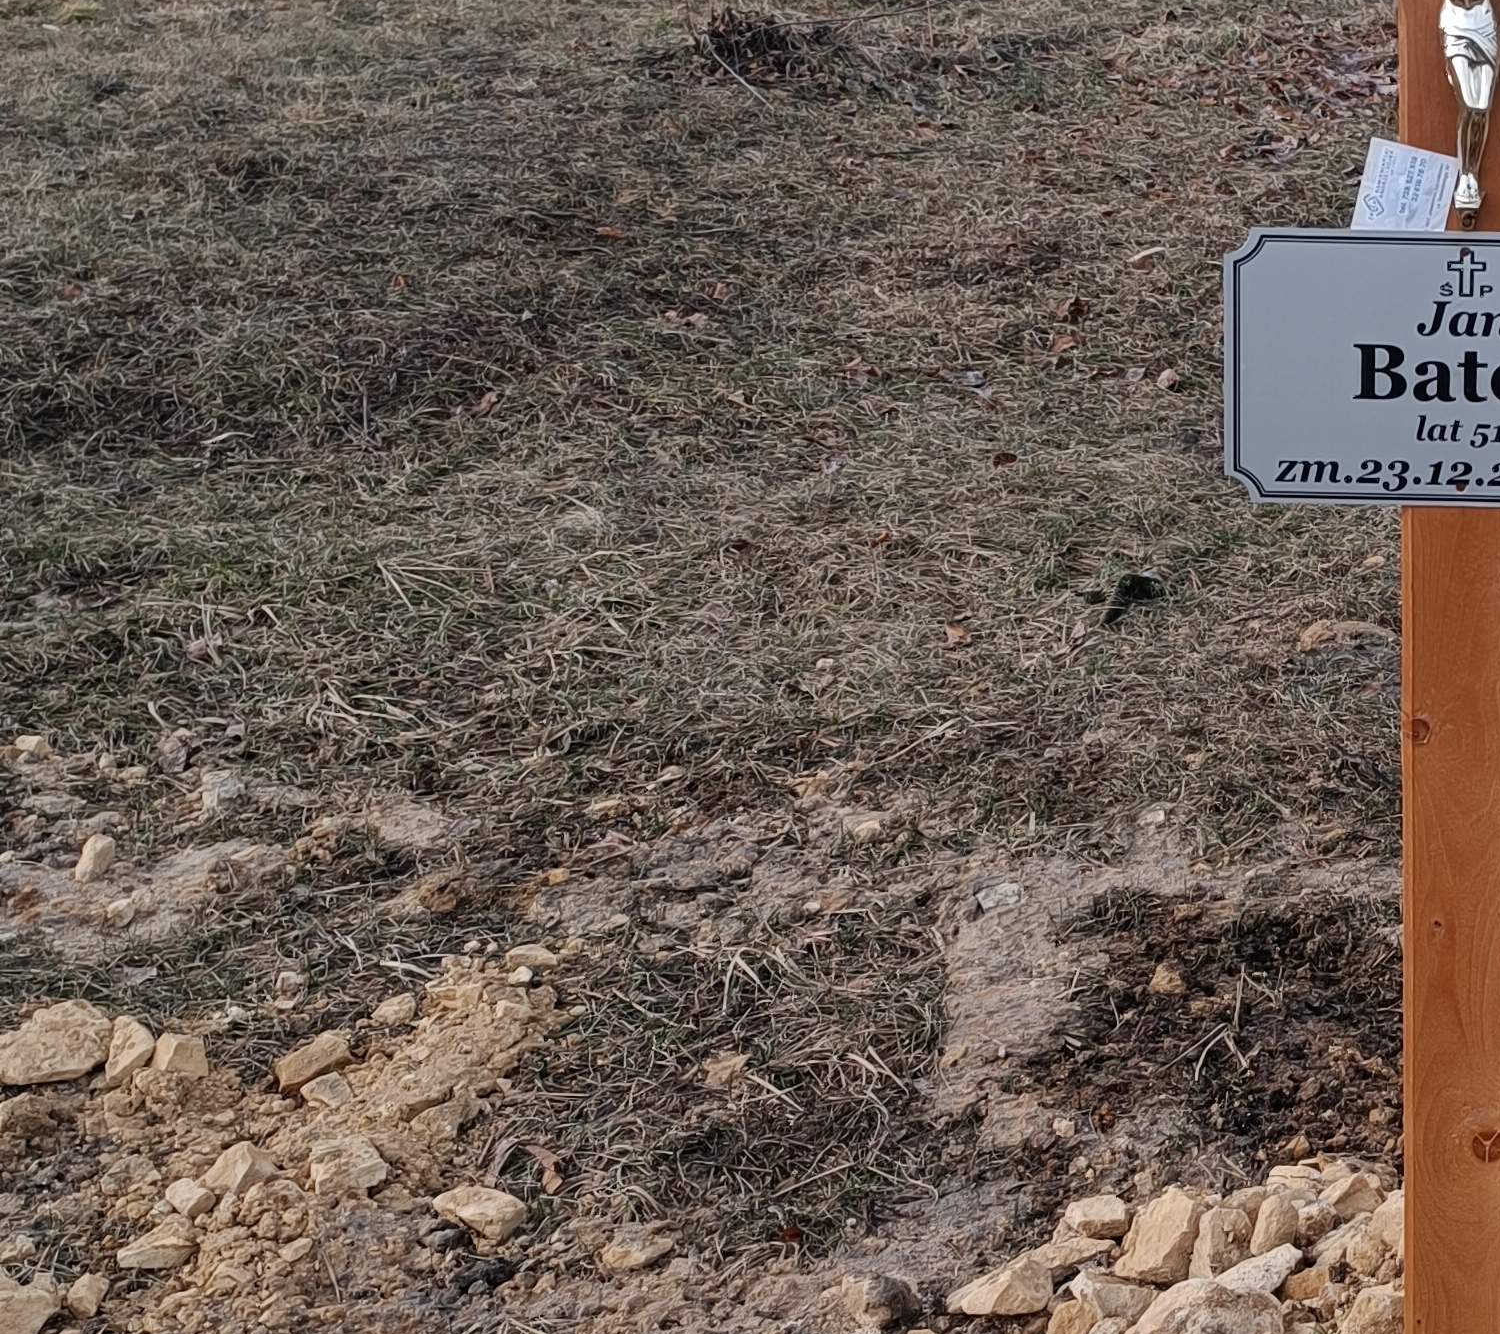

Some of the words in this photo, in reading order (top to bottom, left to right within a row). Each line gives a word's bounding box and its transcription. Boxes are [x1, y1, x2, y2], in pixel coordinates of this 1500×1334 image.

[1439, 281, 1454, 297] Ś
[1479, 285, 1494, 298] P
[1416, 415, 1463, 443] lat
